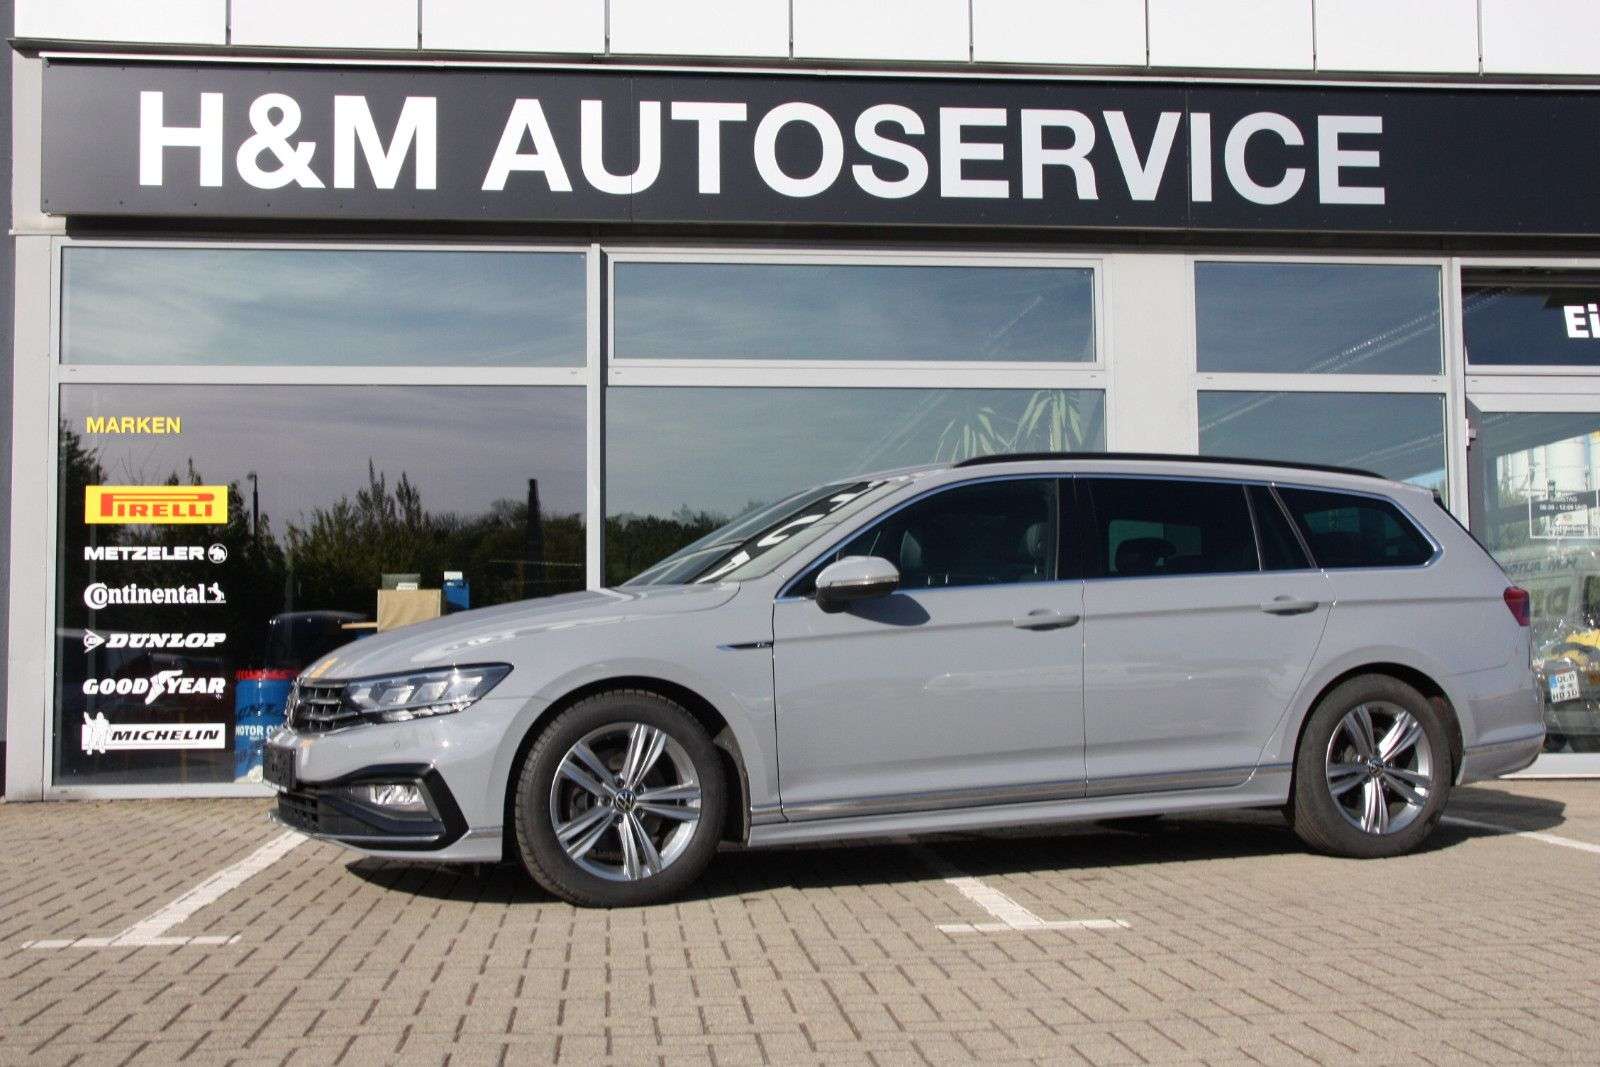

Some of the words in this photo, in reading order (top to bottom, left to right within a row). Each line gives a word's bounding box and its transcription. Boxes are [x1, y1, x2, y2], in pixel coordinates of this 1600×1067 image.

[139, 90, 437, 190] H&M
[480, 97, 1386, 206] AUTOSERVICE
[85, 416, 182, 434] MARKEN
[100, 493, 215, 517] PIRELLI
[84, 546, 205, 561] METZELER
[83, 582, 207, 610] Continental
[105, 633, 227, 648] DUNLOP
[111, 730, 220, 741] MICHELIN
